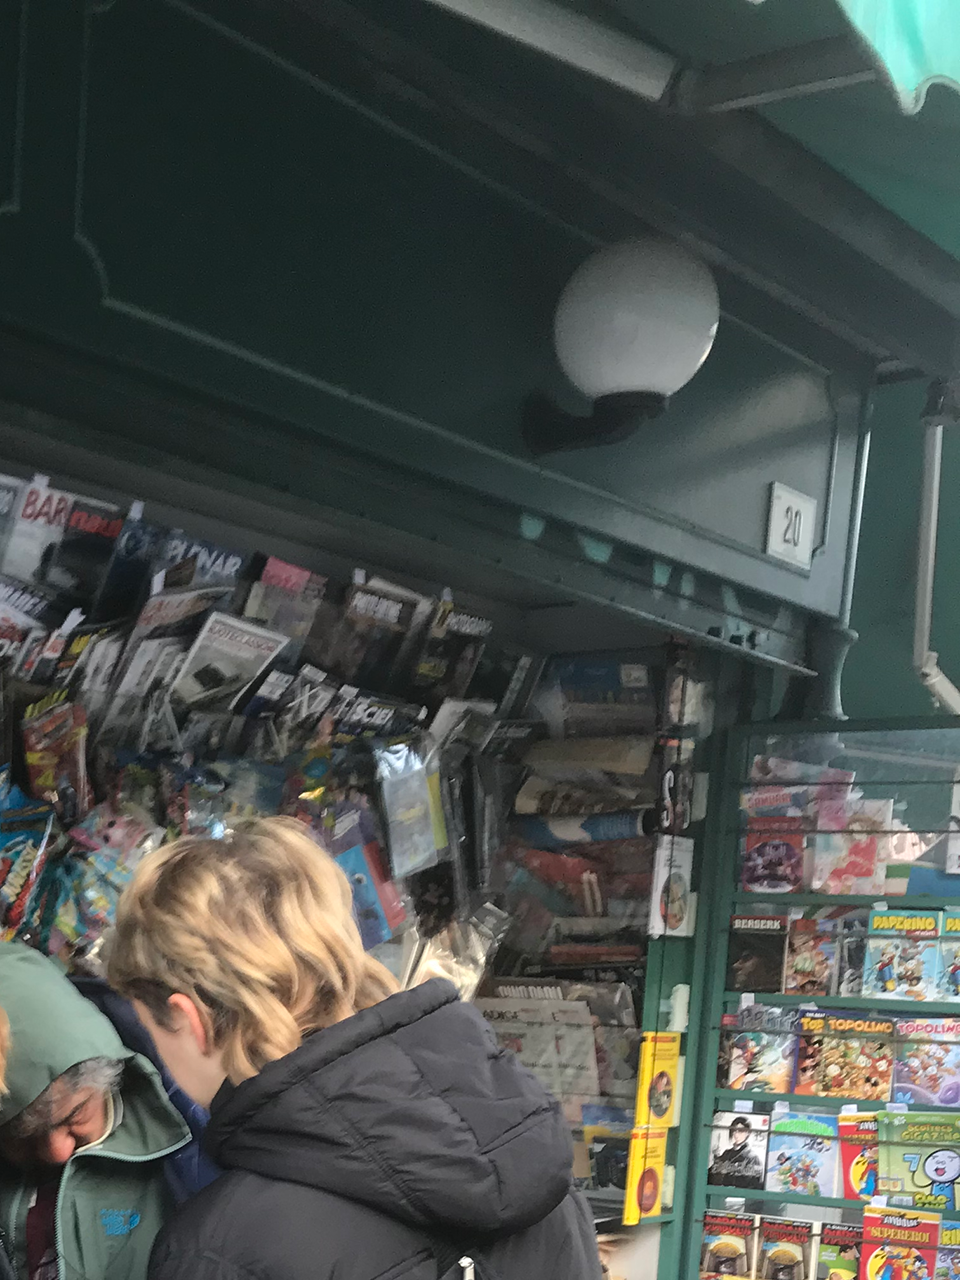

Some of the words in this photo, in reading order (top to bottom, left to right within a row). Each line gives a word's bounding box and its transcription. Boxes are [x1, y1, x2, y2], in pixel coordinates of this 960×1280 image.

[782, 505, 804, 547] 20
[733, 918, 781, 930] BERSERK
[872, 915, 936, 931] PAPERINO
[828, 1018, 894, 1033] TOPOLINO
[903, 1153, 921, 1172] 7
[869, 1226, 931, 1243] SUPEREROI
